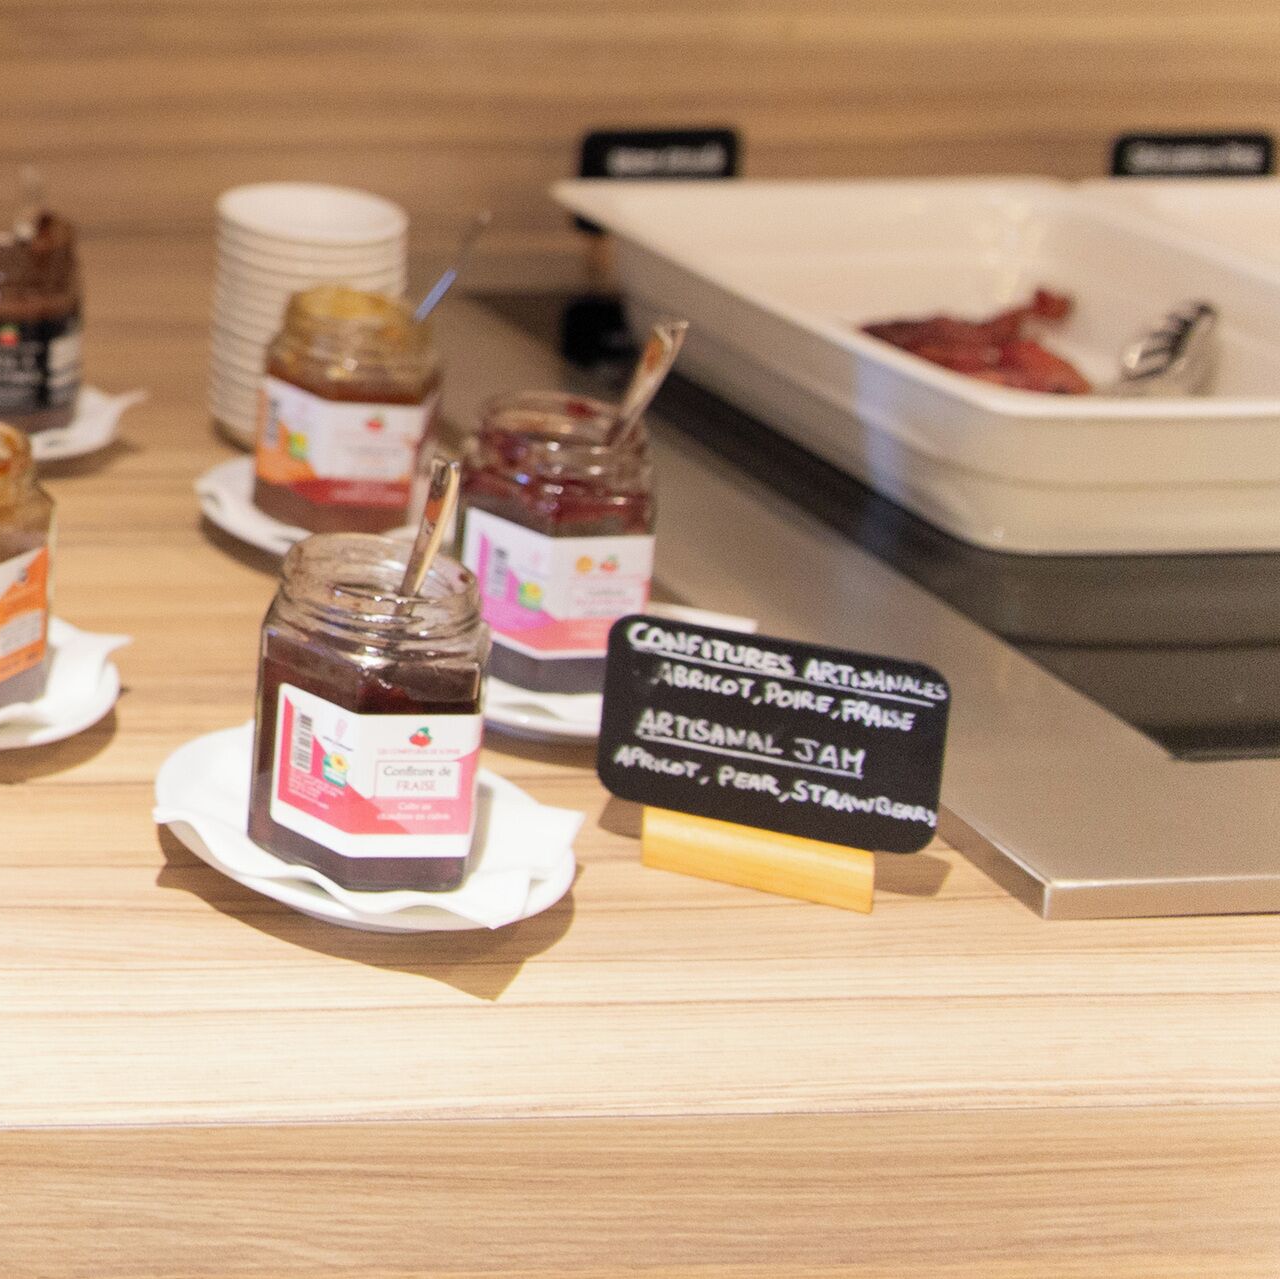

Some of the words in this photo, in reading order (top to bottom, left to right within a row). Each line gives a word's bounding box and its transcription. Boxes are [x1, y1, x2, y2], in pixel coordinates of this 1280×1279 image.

[626, 622, 795, 676] CONFITURES
[802, 658, 949, 701] ARTISANALES
[635, 708, 785, 755] ARTISANAL
[794, 737, 867, 775] JAM
[842, 698, 916, 732] FRAISE
[395, 780, 437, 792] FRAISE
[612, 745, 710, 786] APRICOT,
[789, 780, 938, 829] STRAWBERRY
